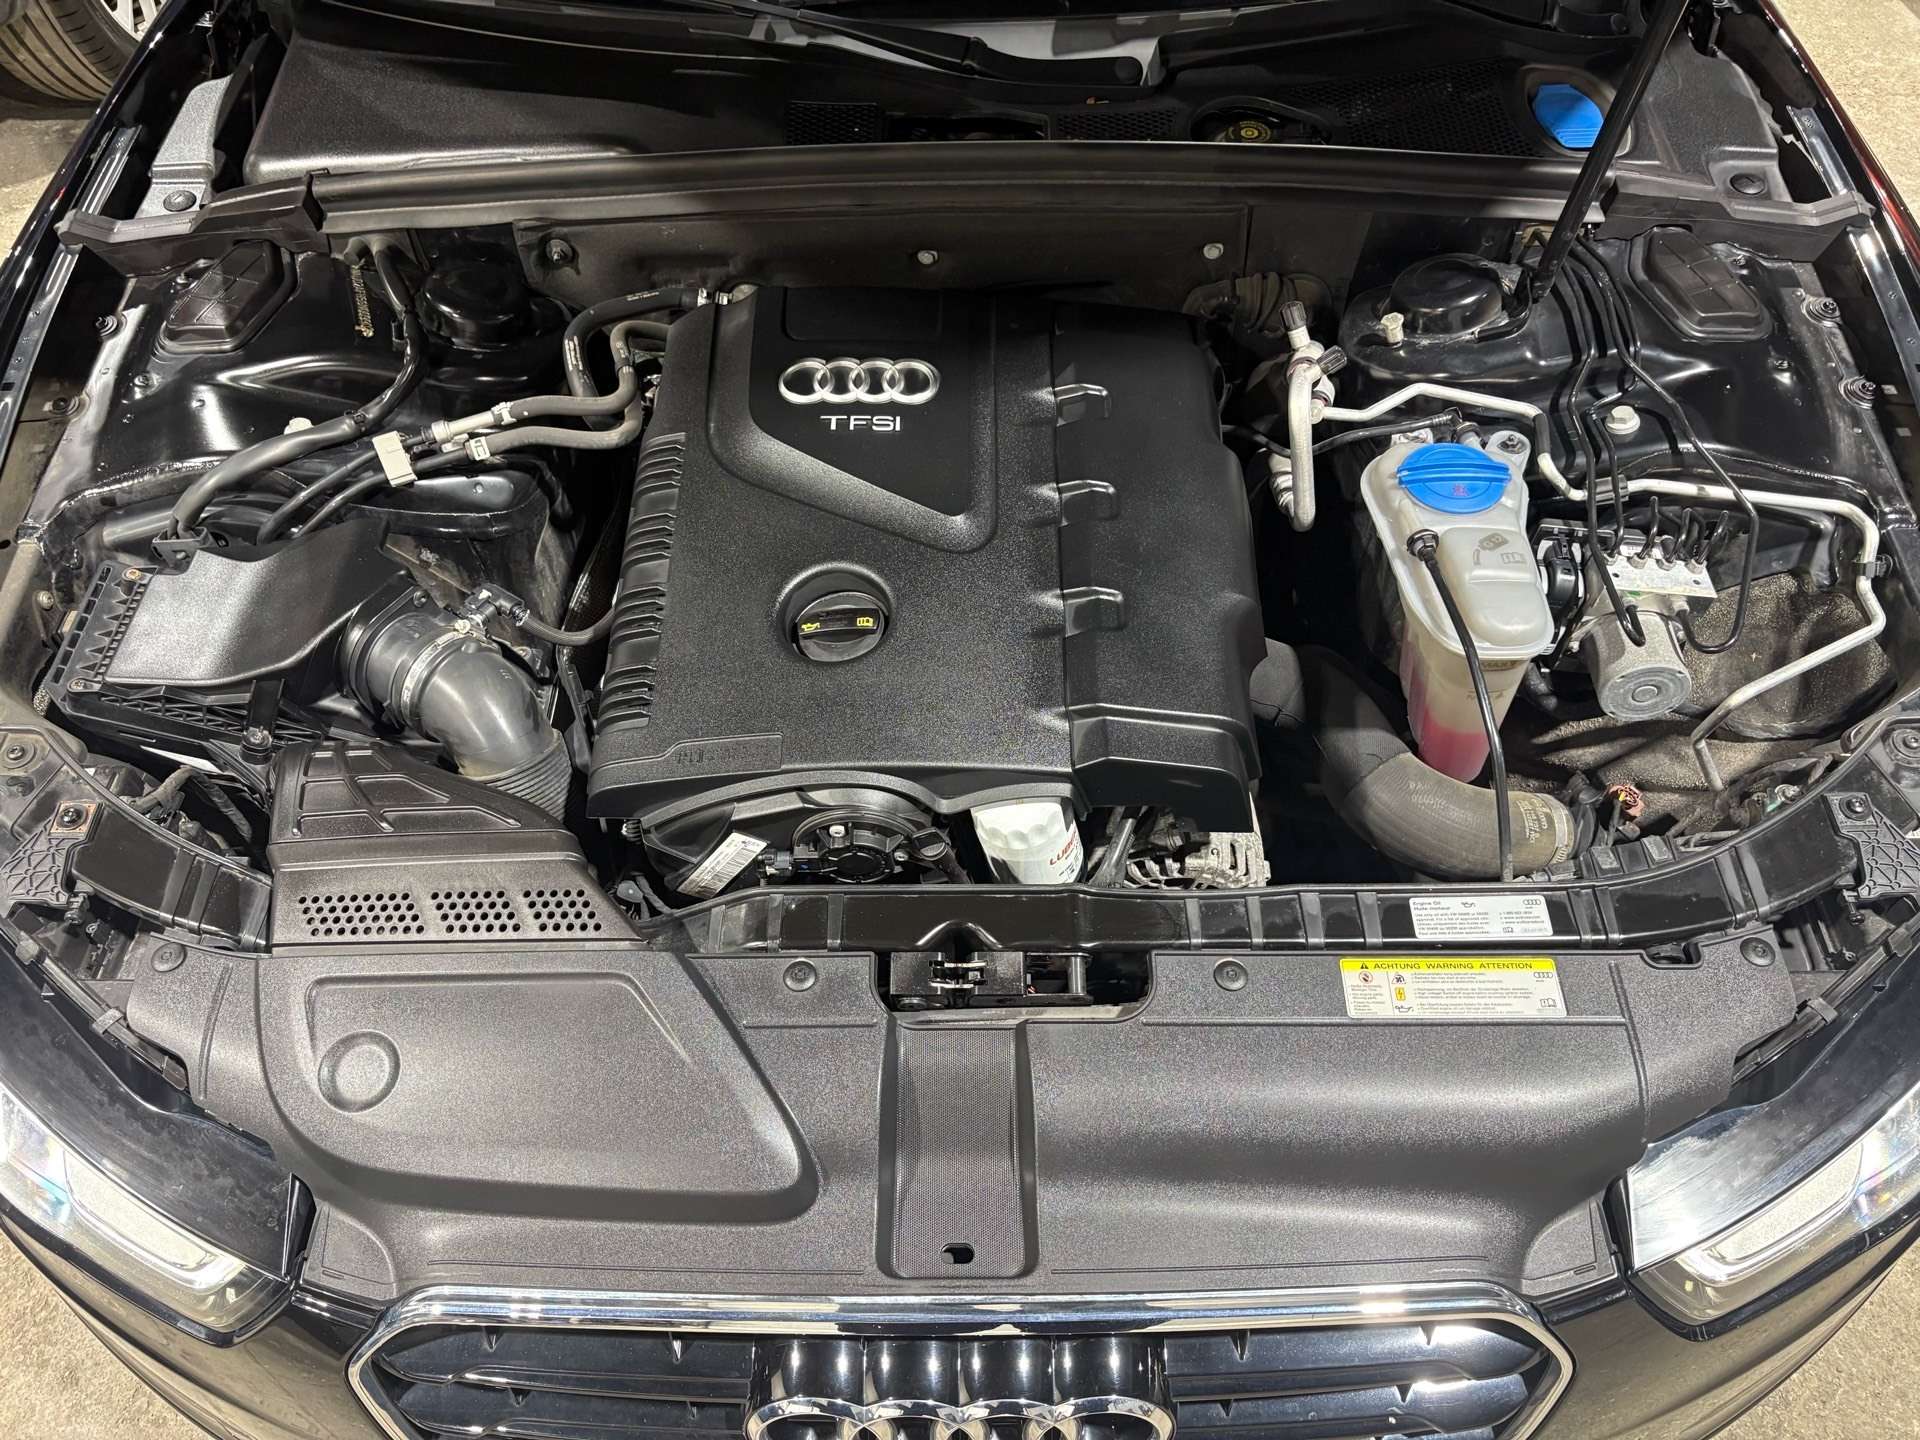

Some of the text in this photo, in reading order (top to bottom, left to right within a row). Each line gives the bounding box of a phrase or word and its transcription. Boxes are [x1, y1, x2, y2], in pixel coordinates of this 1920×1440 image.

[820, 415, 901, 432] TFSI
[1373, 962, 1533, 970] ACHTUNG WARNING ATTENTION
